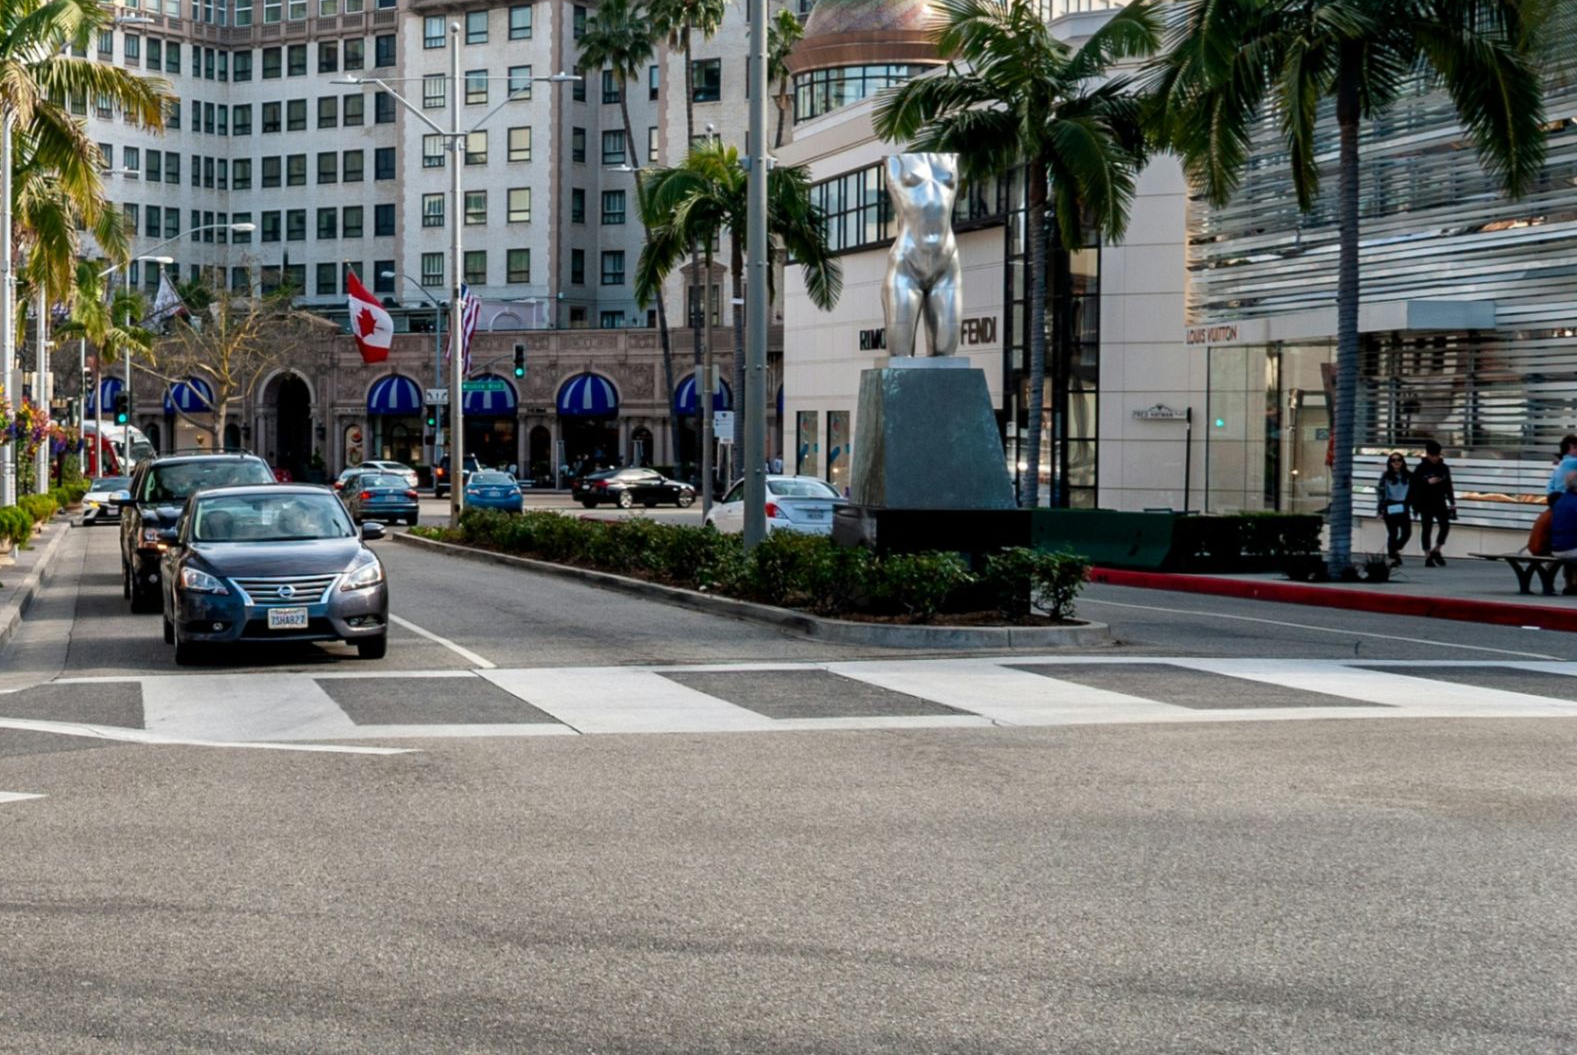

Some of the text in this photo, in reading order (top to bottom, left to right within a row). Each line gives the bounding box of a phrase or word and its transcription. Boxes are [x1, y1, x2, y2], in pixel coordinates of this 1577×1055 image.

[960, 317, 997, 345] FENDI
[1186, 325, 1237, 344] LOUIS VUITTON
